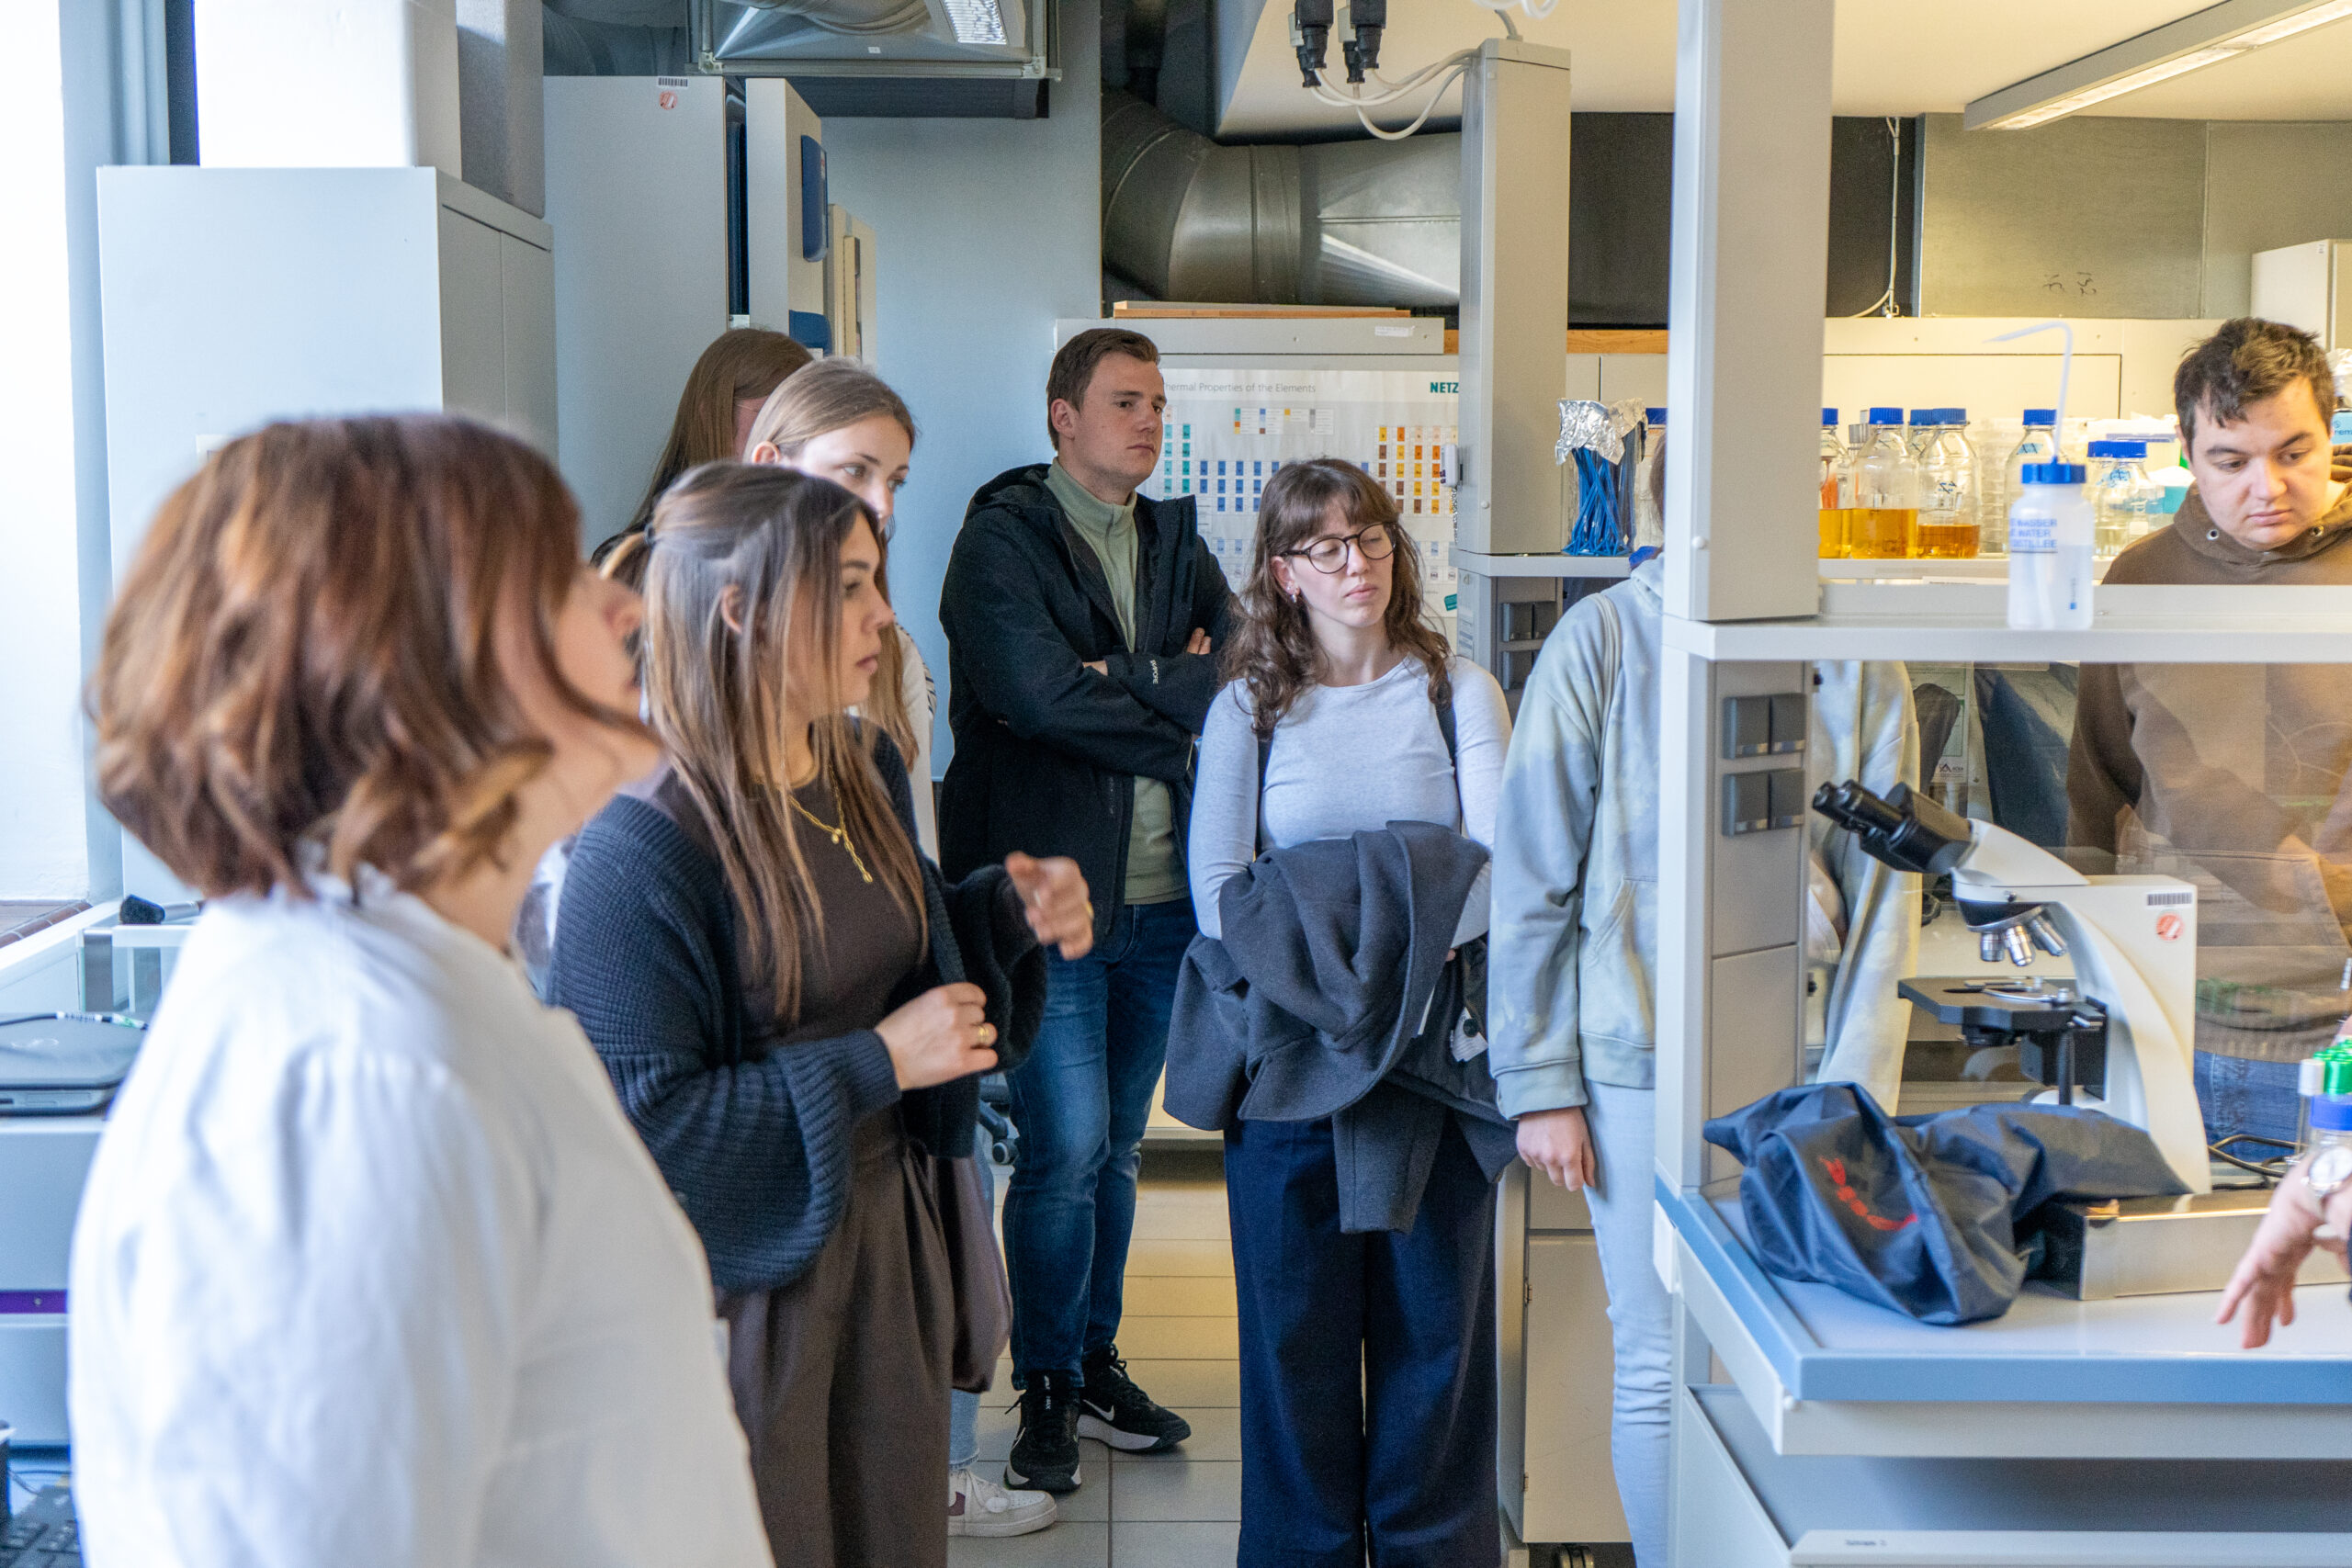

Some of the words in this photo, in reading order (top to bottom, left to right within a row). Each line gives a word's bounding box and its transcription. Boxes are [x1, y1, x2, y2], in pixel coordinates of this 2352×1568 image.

[1199, 382, 1243, 392] Properties
[1245, 383, 1255, 392] of
[1258, 383, 1272, 392] the
[1275, 383, 1316, 392] Elements
[1430, 381, 1459, 393] NETZ
